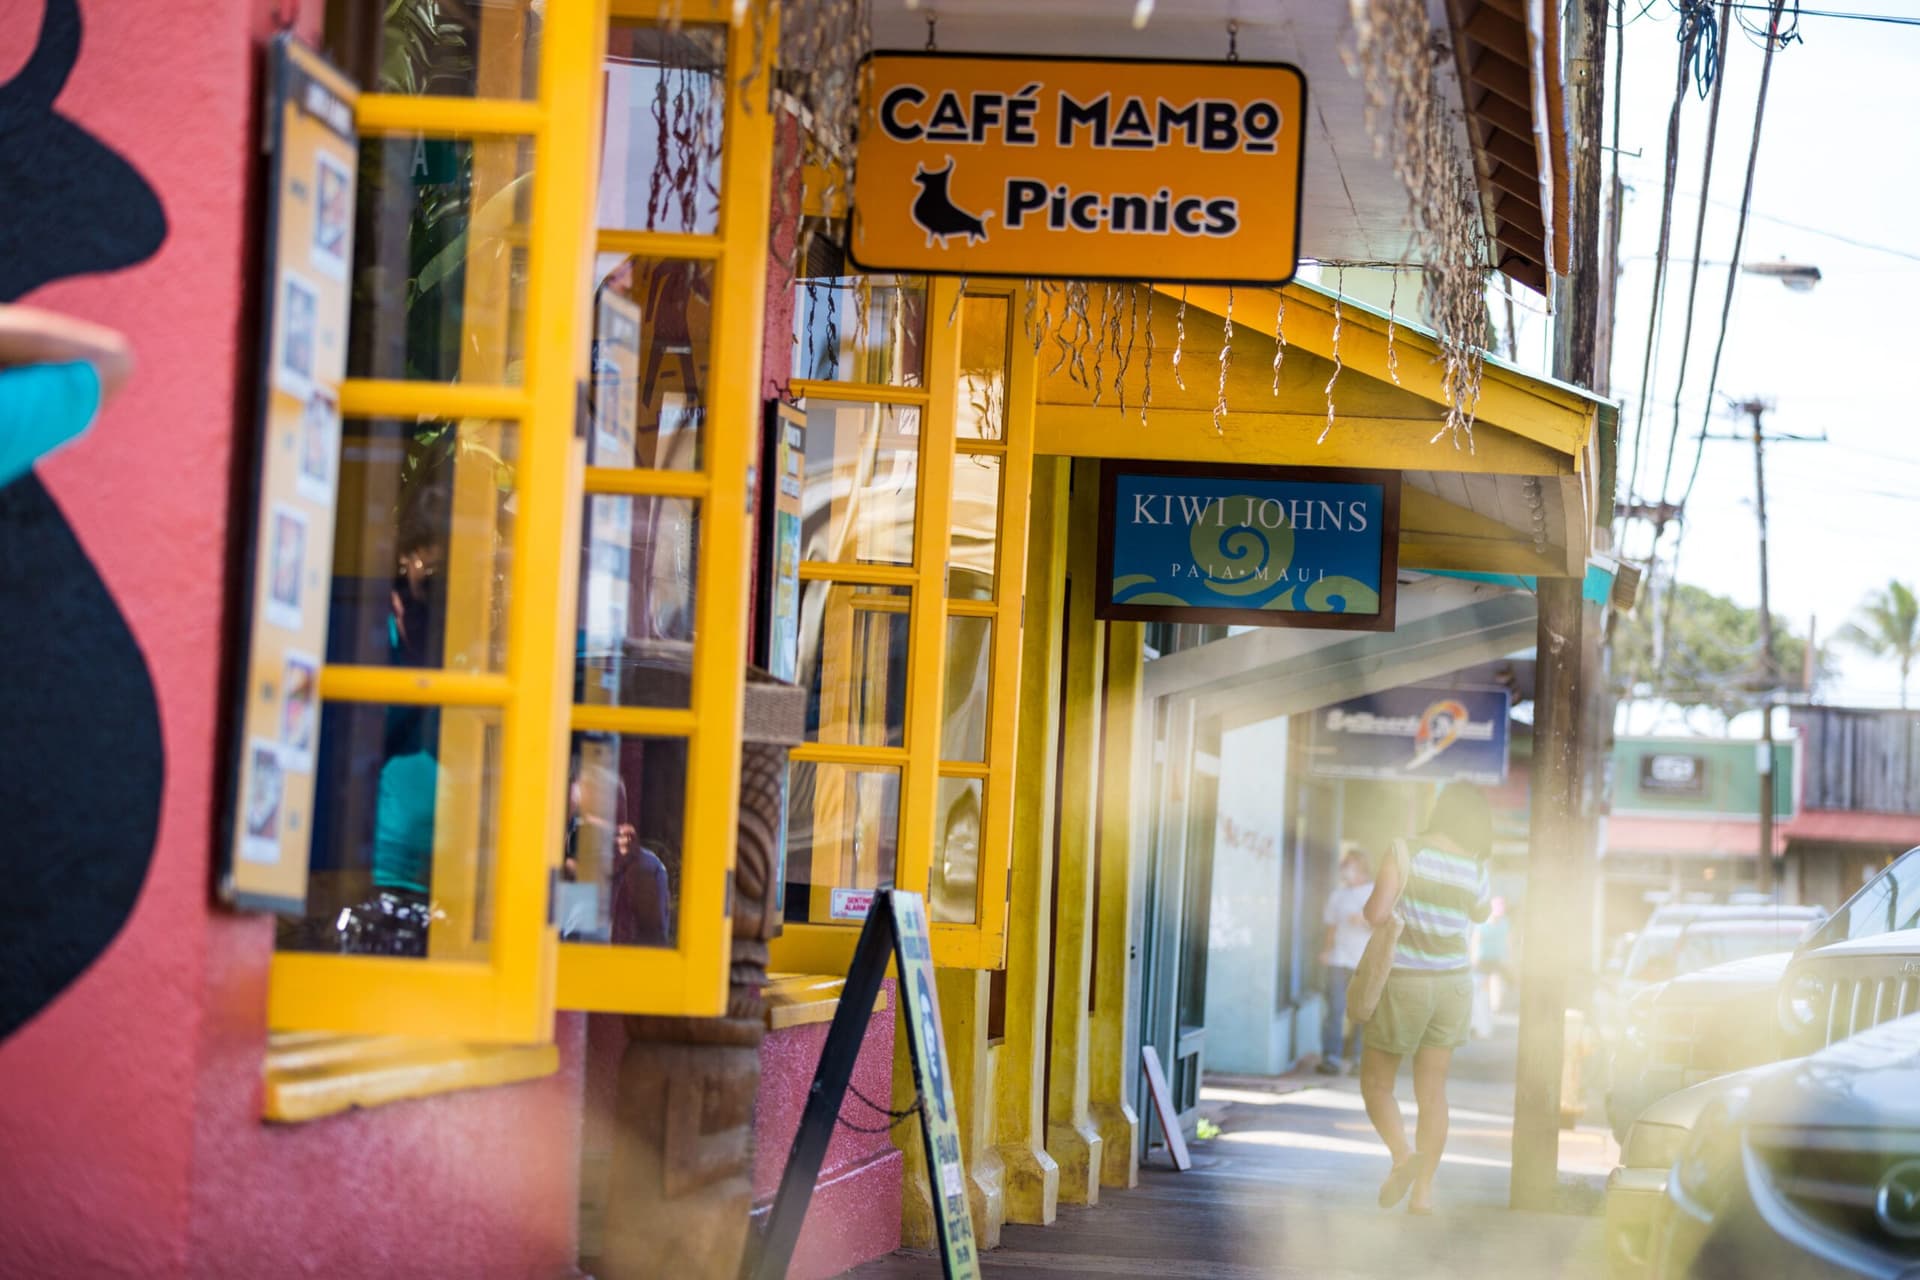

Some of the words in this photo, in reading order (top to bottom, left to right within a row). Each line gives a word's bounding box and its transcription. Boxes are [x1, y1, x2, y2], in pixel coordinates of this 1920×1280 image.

[880, 82, 1043, 144] CAFÉ
[1057, 92, 1281, 153] MAMBO
[1132, 494, 1226, 527] KIWI
[1241, 498, 1368, 532] JOHNS
